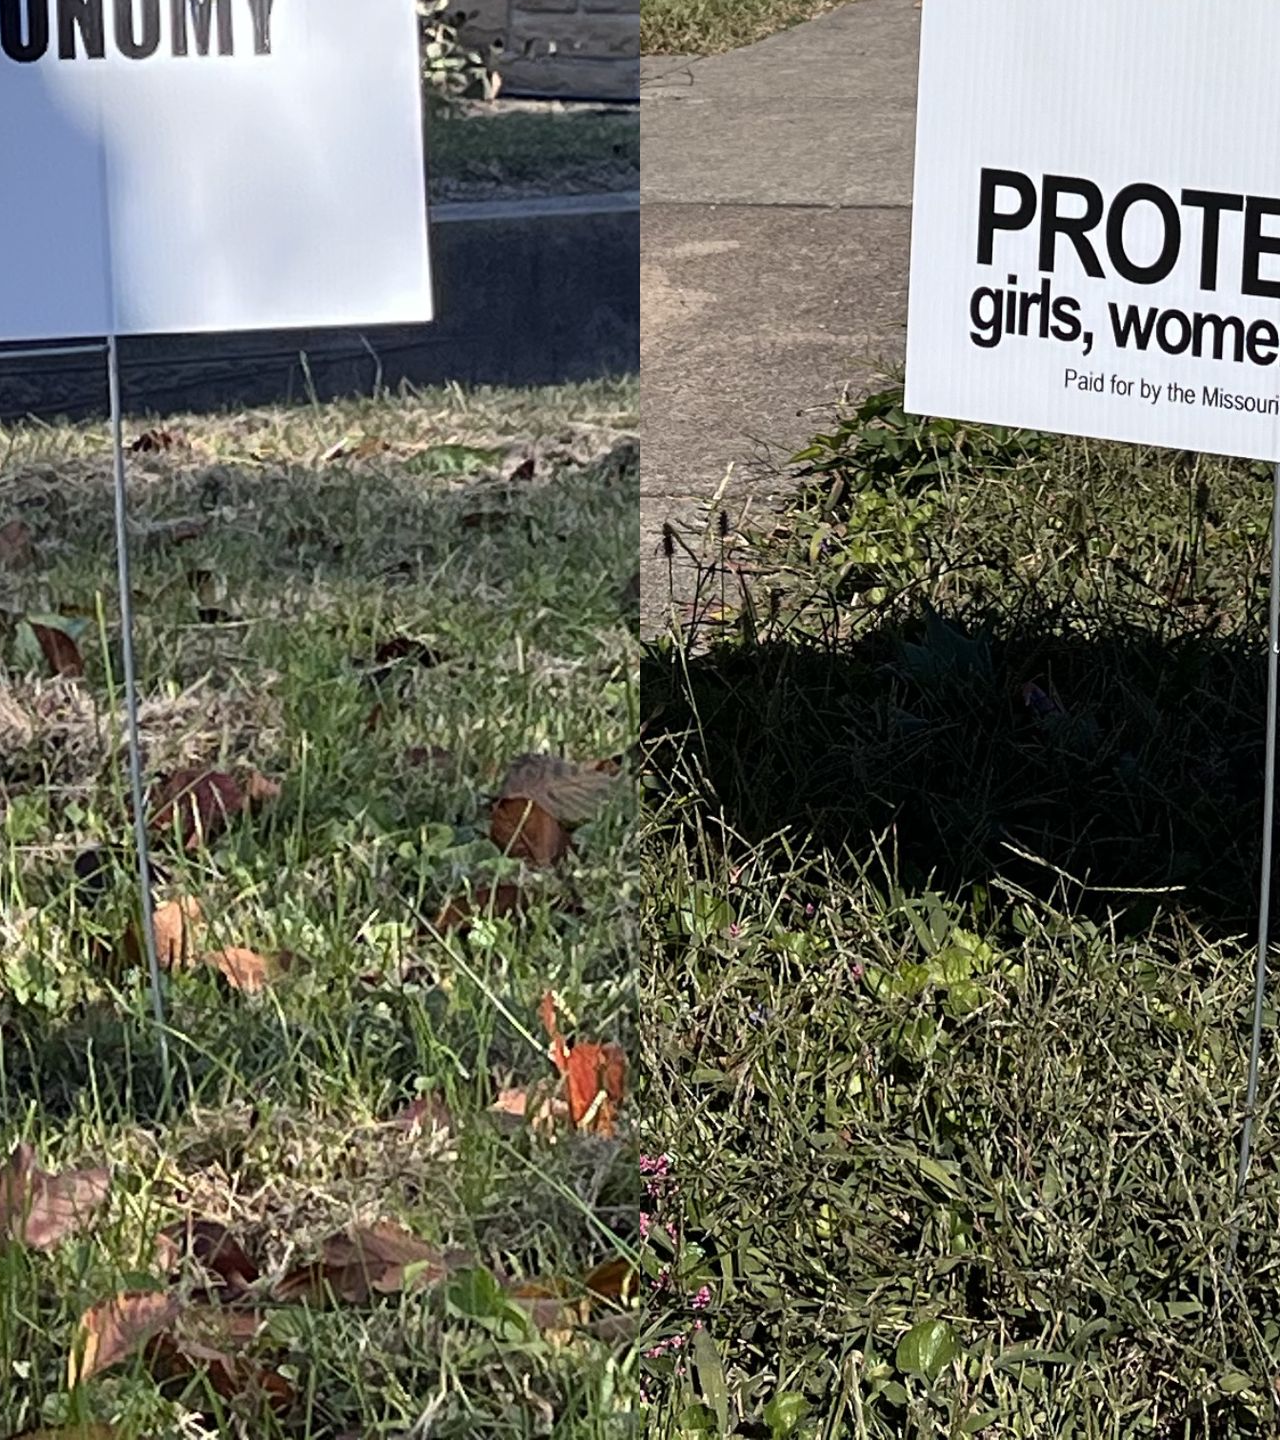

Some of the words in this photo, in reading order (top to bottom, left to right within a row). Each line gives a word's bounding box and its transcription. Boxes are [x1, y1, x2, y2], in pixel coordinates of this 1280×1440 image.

[969, 274, 1094, 356] girls,
[1064, 368, 1105, 393] Paid
[1110, 373, 1135, 397] for
[1140, 377, 1163, 406] by
[1166, 380, 1196, 405] the
[1201, 384, 1280, 417] Missouri
